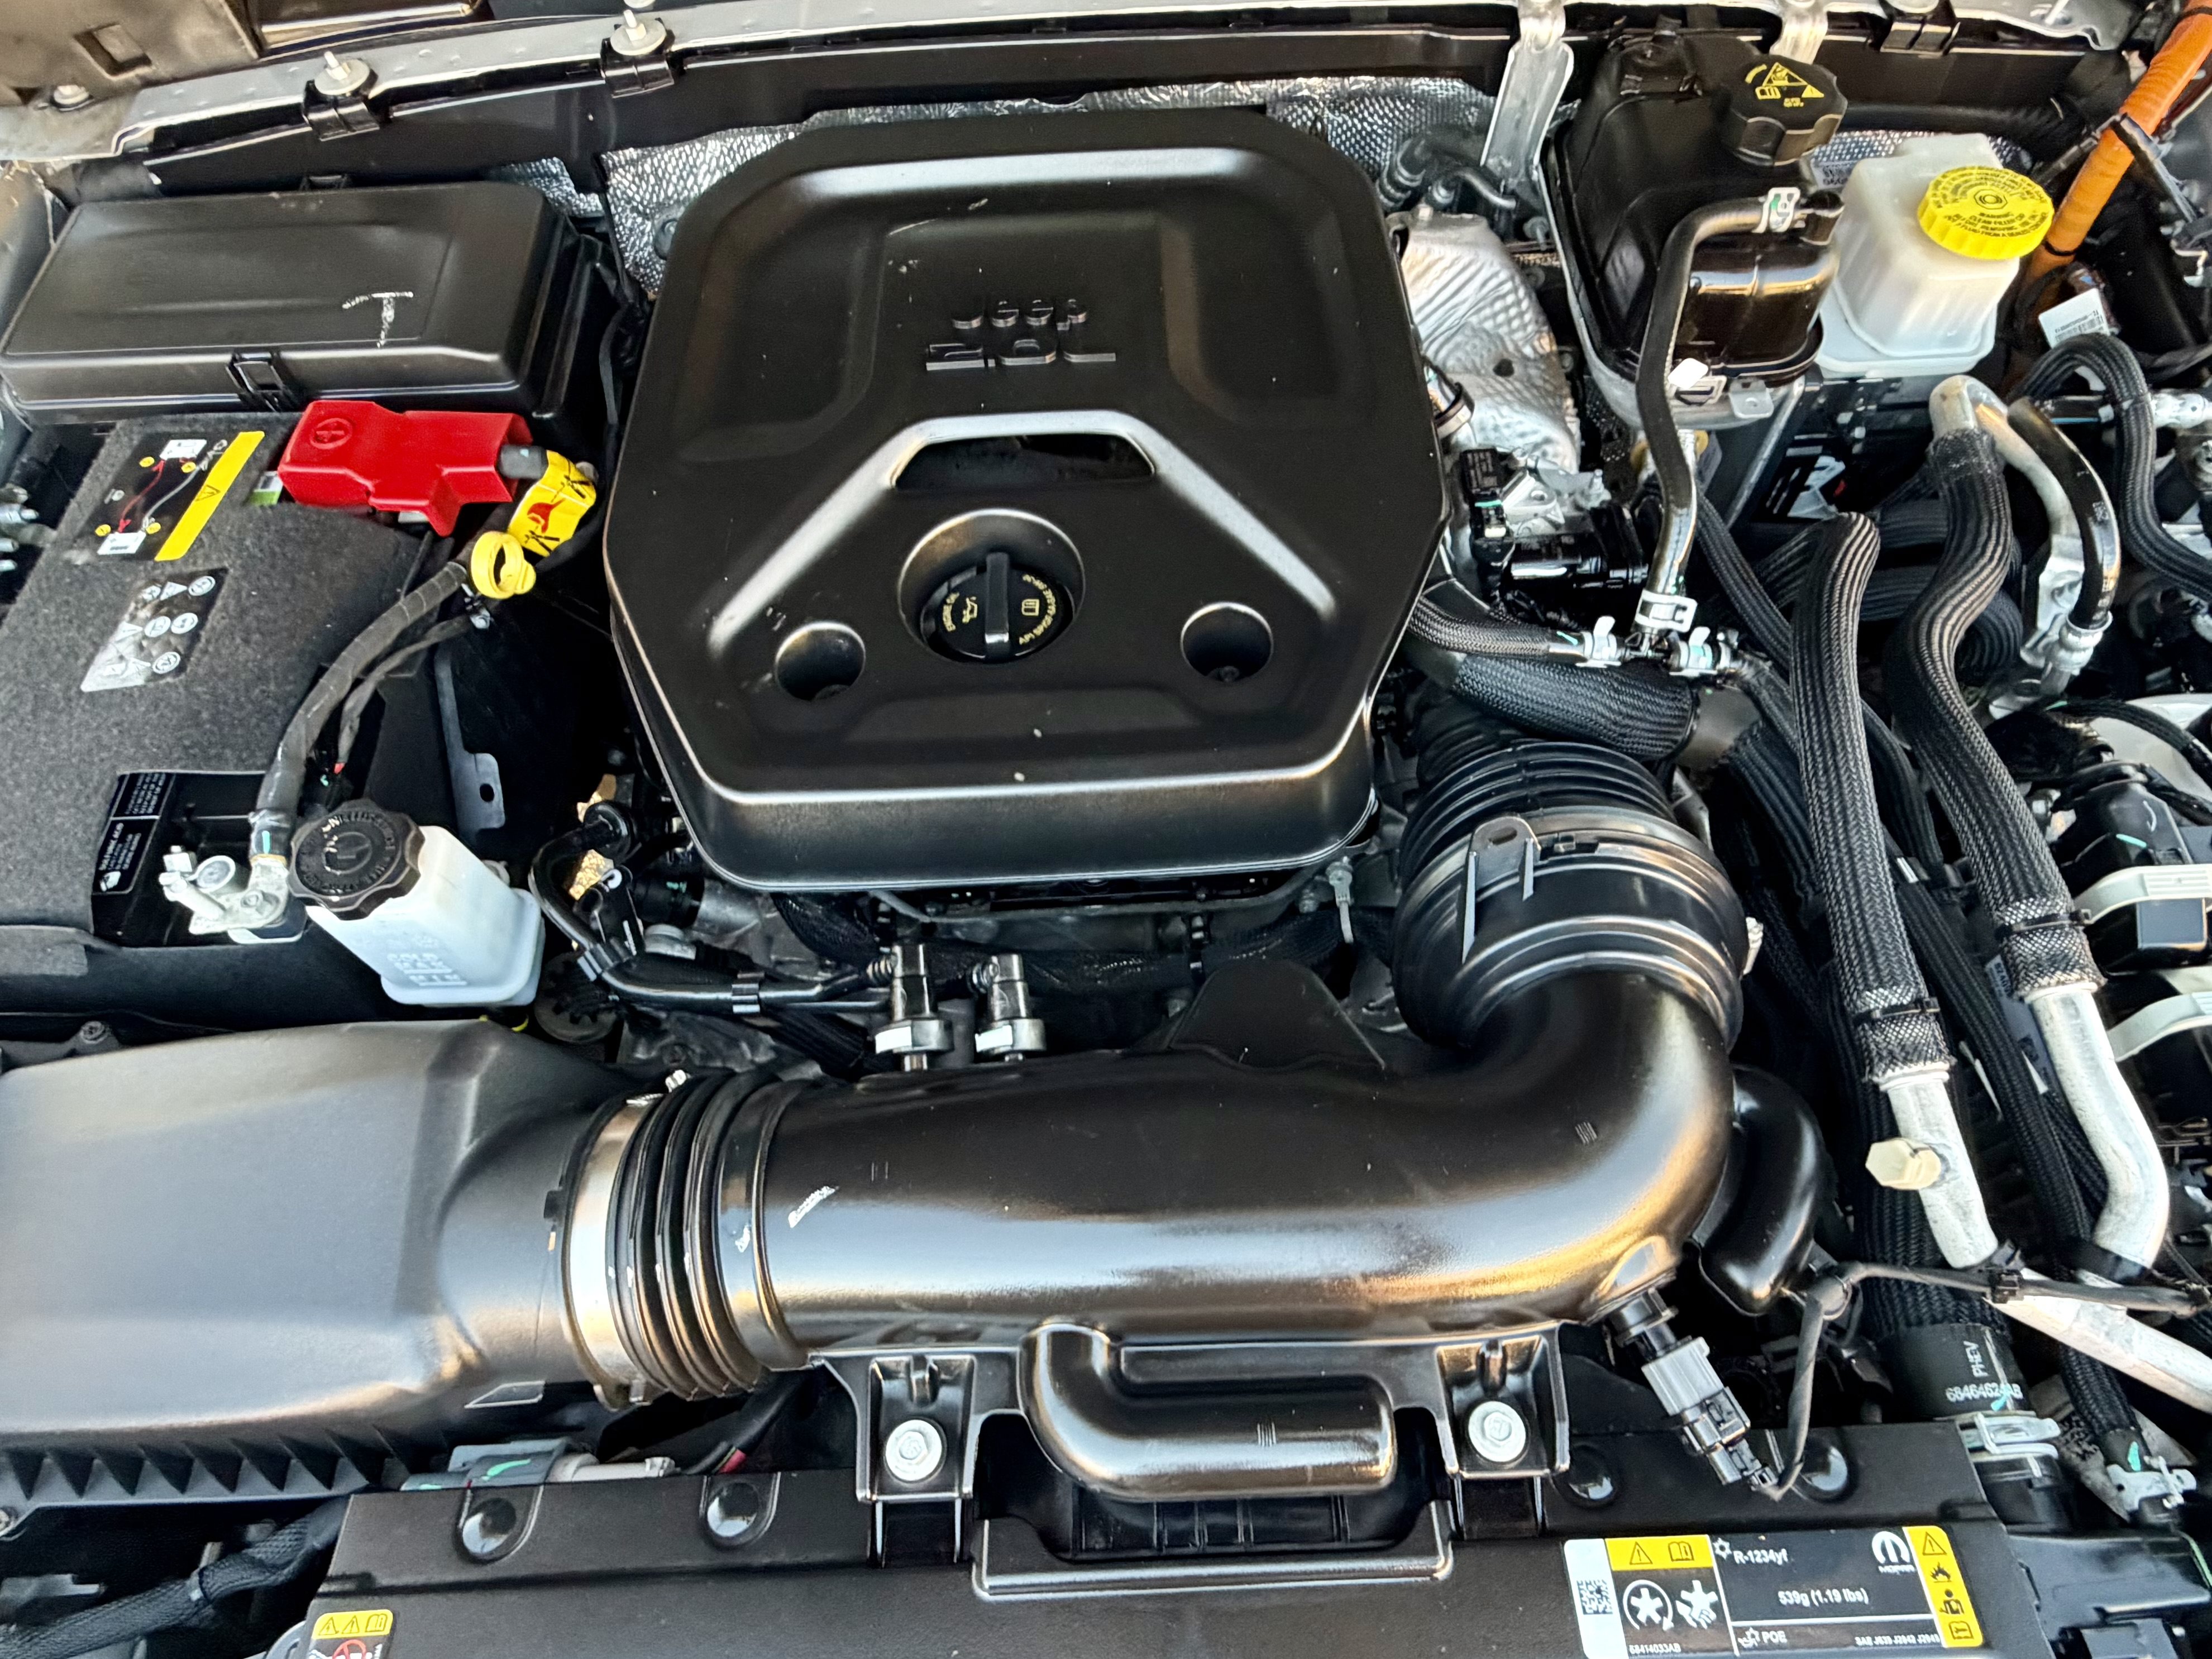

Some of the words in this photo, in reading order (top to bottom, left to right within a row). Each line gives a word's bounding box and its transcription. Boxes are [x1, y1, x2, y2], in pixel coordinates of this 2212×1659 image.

[1963, 1340, 1989, 1378] PHEV
[1733, 1548, 1788, 1565] R-1234yf
[1778, 1590, 1810, 1607] 539g
[1810, 1589, 1842, 1607] (1.19
[1842, 1588, 1869, 1605] lbs)
[1762, 1629, 1786, 1644] POE
